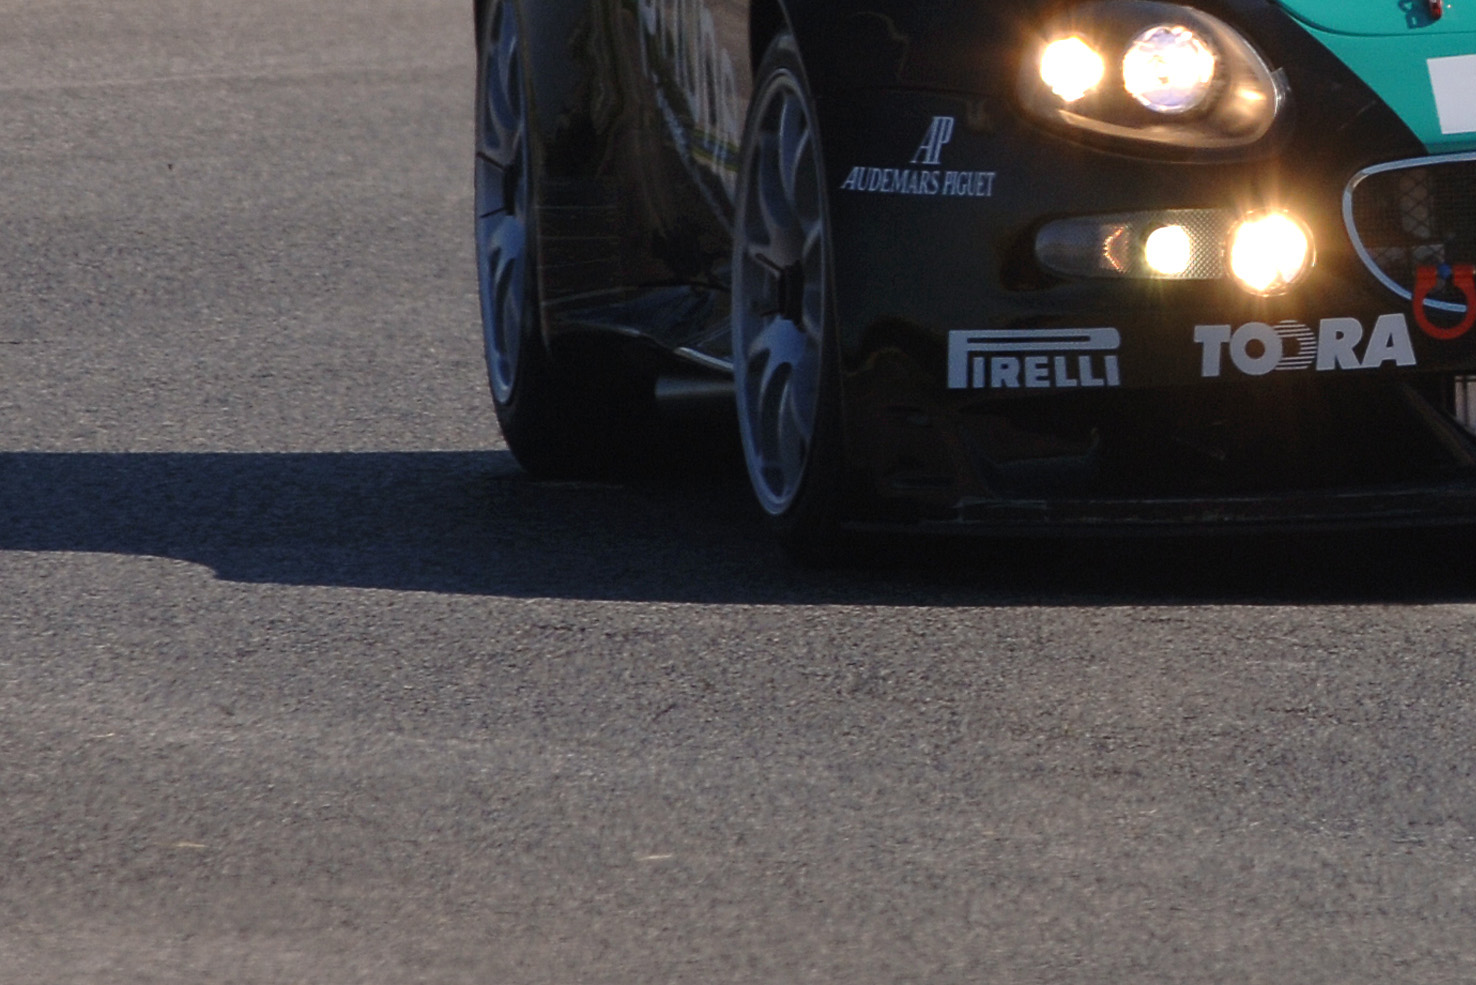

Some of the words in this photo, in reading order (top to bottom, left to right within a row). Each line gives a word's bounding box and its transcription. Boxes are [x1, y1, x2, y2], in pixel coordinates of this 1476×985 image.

[910, 116, 954, 164] AP
[840, 166, 940, 194] AUDEMARS
[941, 171, 995, 196] PIGUET
[947, 328, 1121, 389] PIRELLI
[1194, 312, 1417, 377] TOORA
